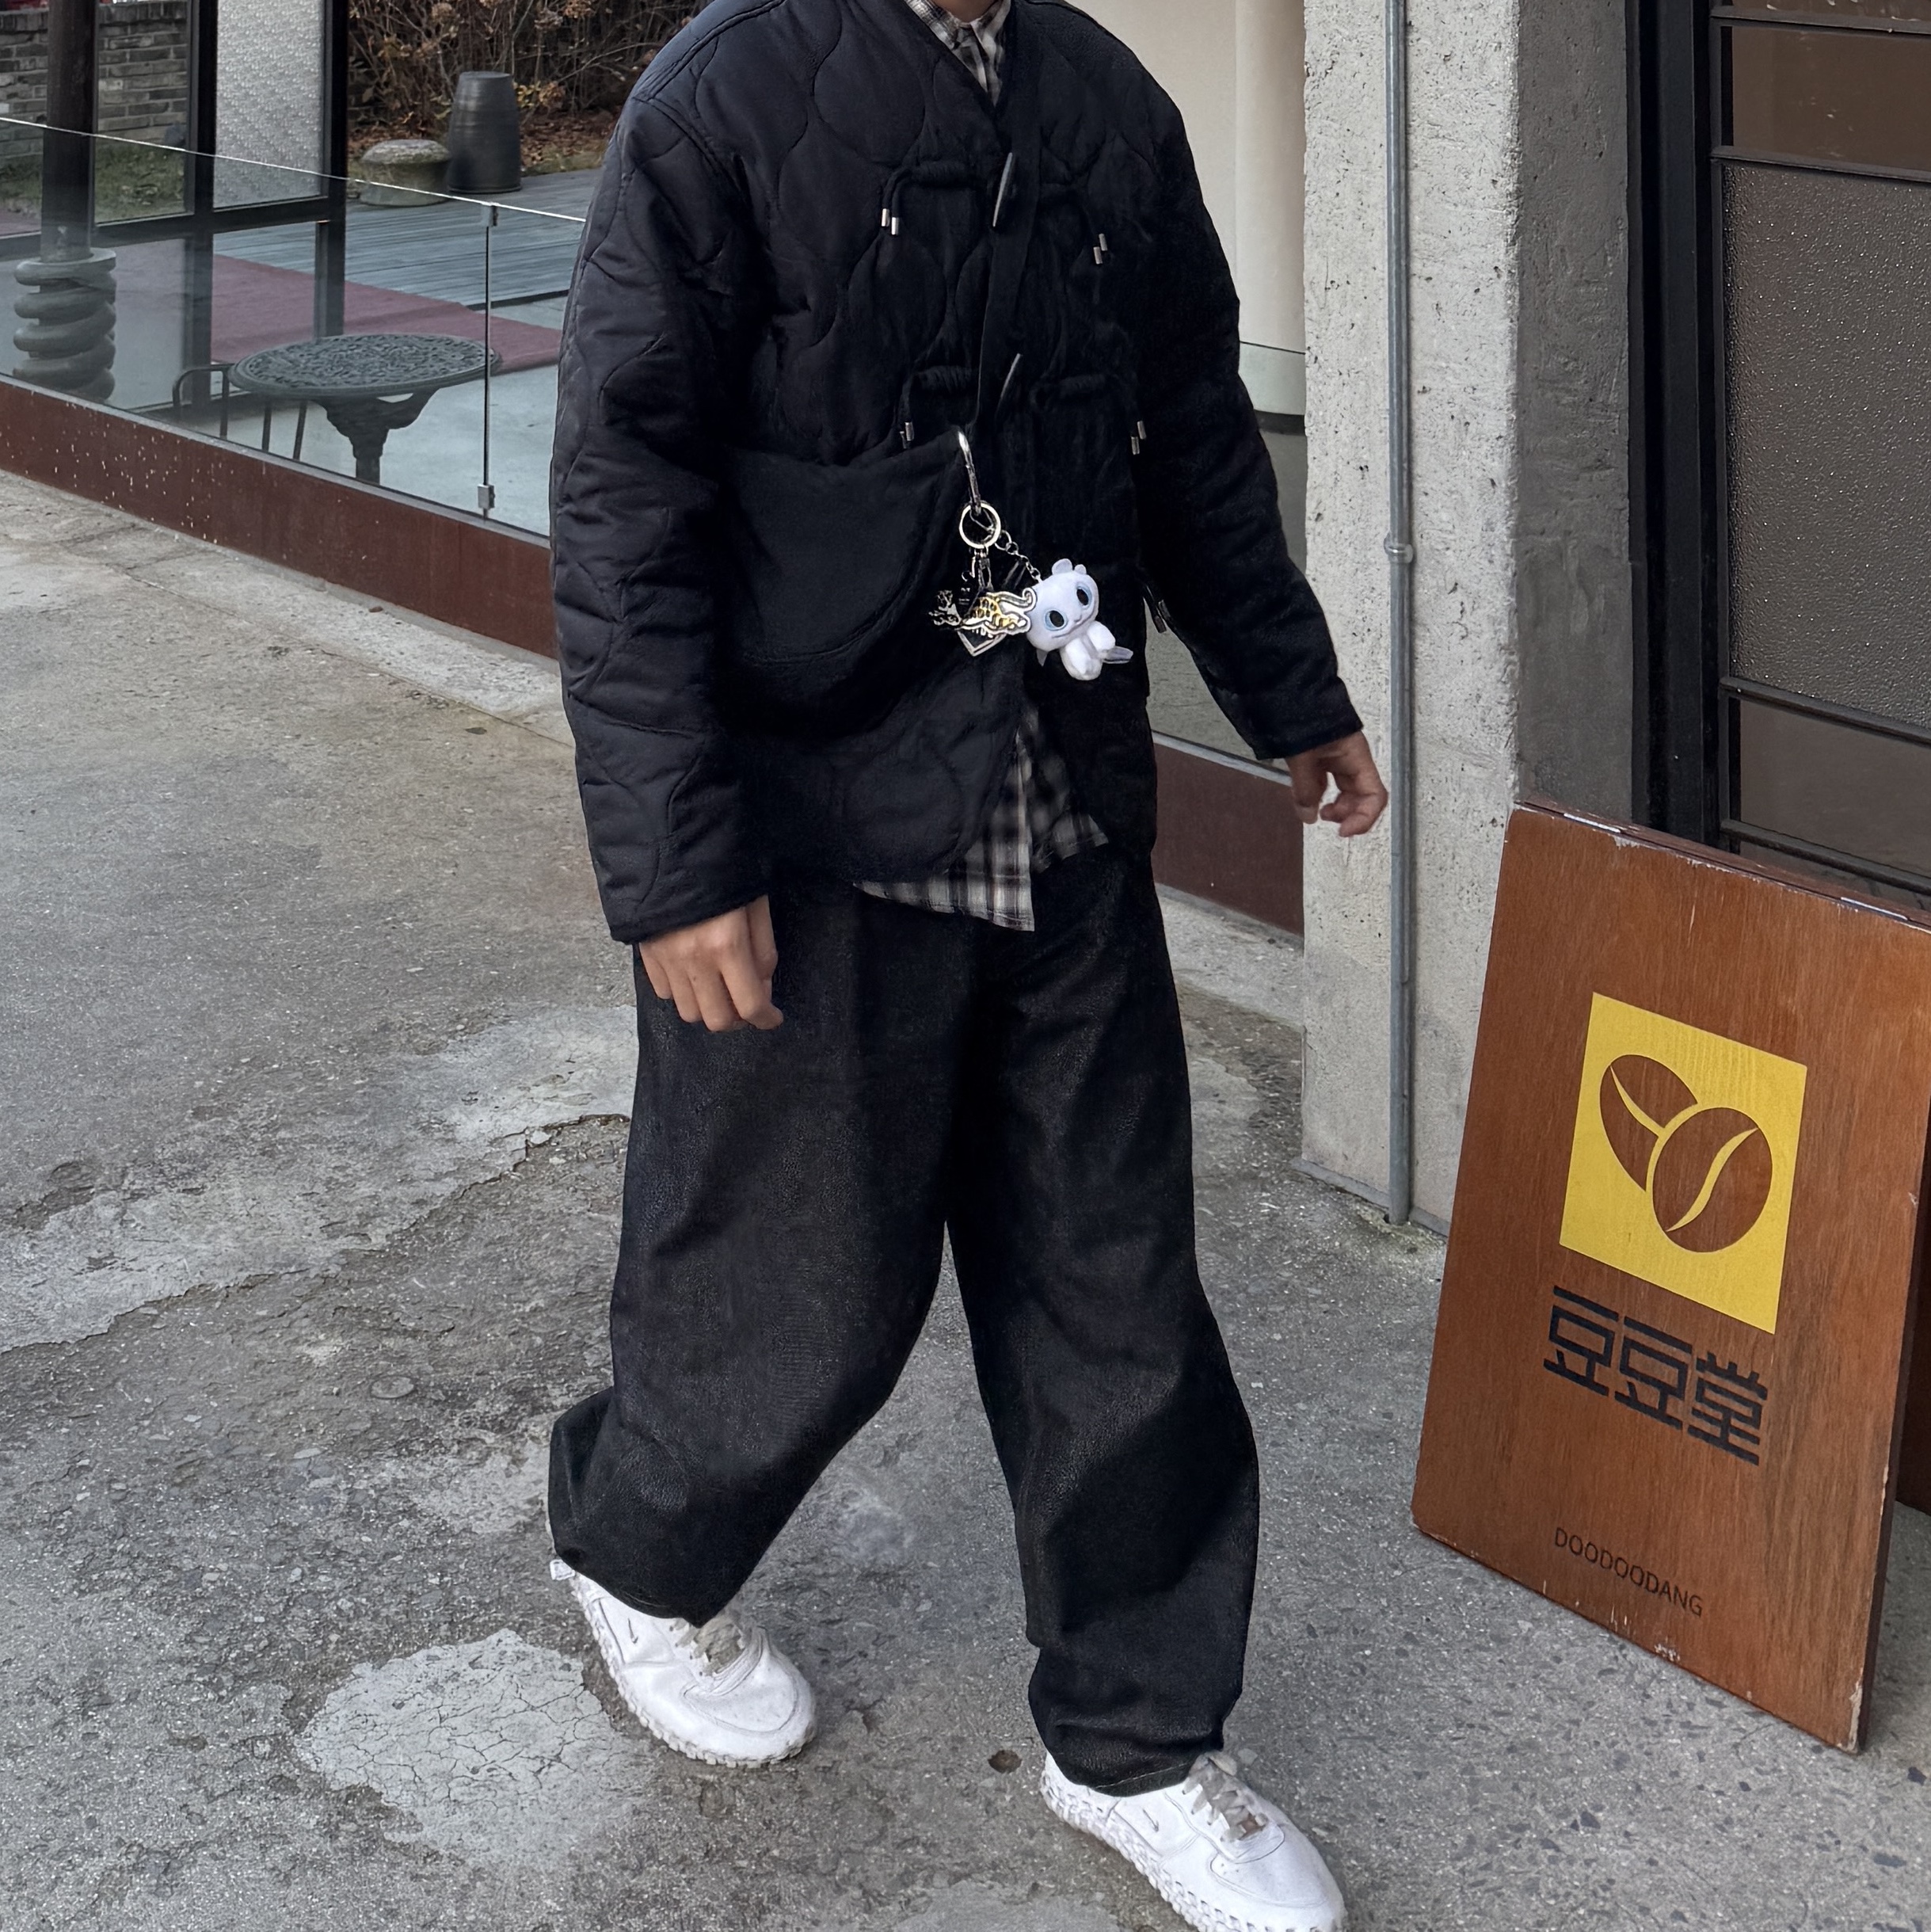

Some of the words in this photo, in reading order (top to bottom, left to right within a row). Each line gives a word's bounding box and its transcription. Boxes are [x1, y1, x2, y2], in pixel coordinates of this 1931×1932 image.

[1544, 1285, 1768, 1465] 豆豆堂
[1555, 1527, 1703, 1617] DOODOODANG
